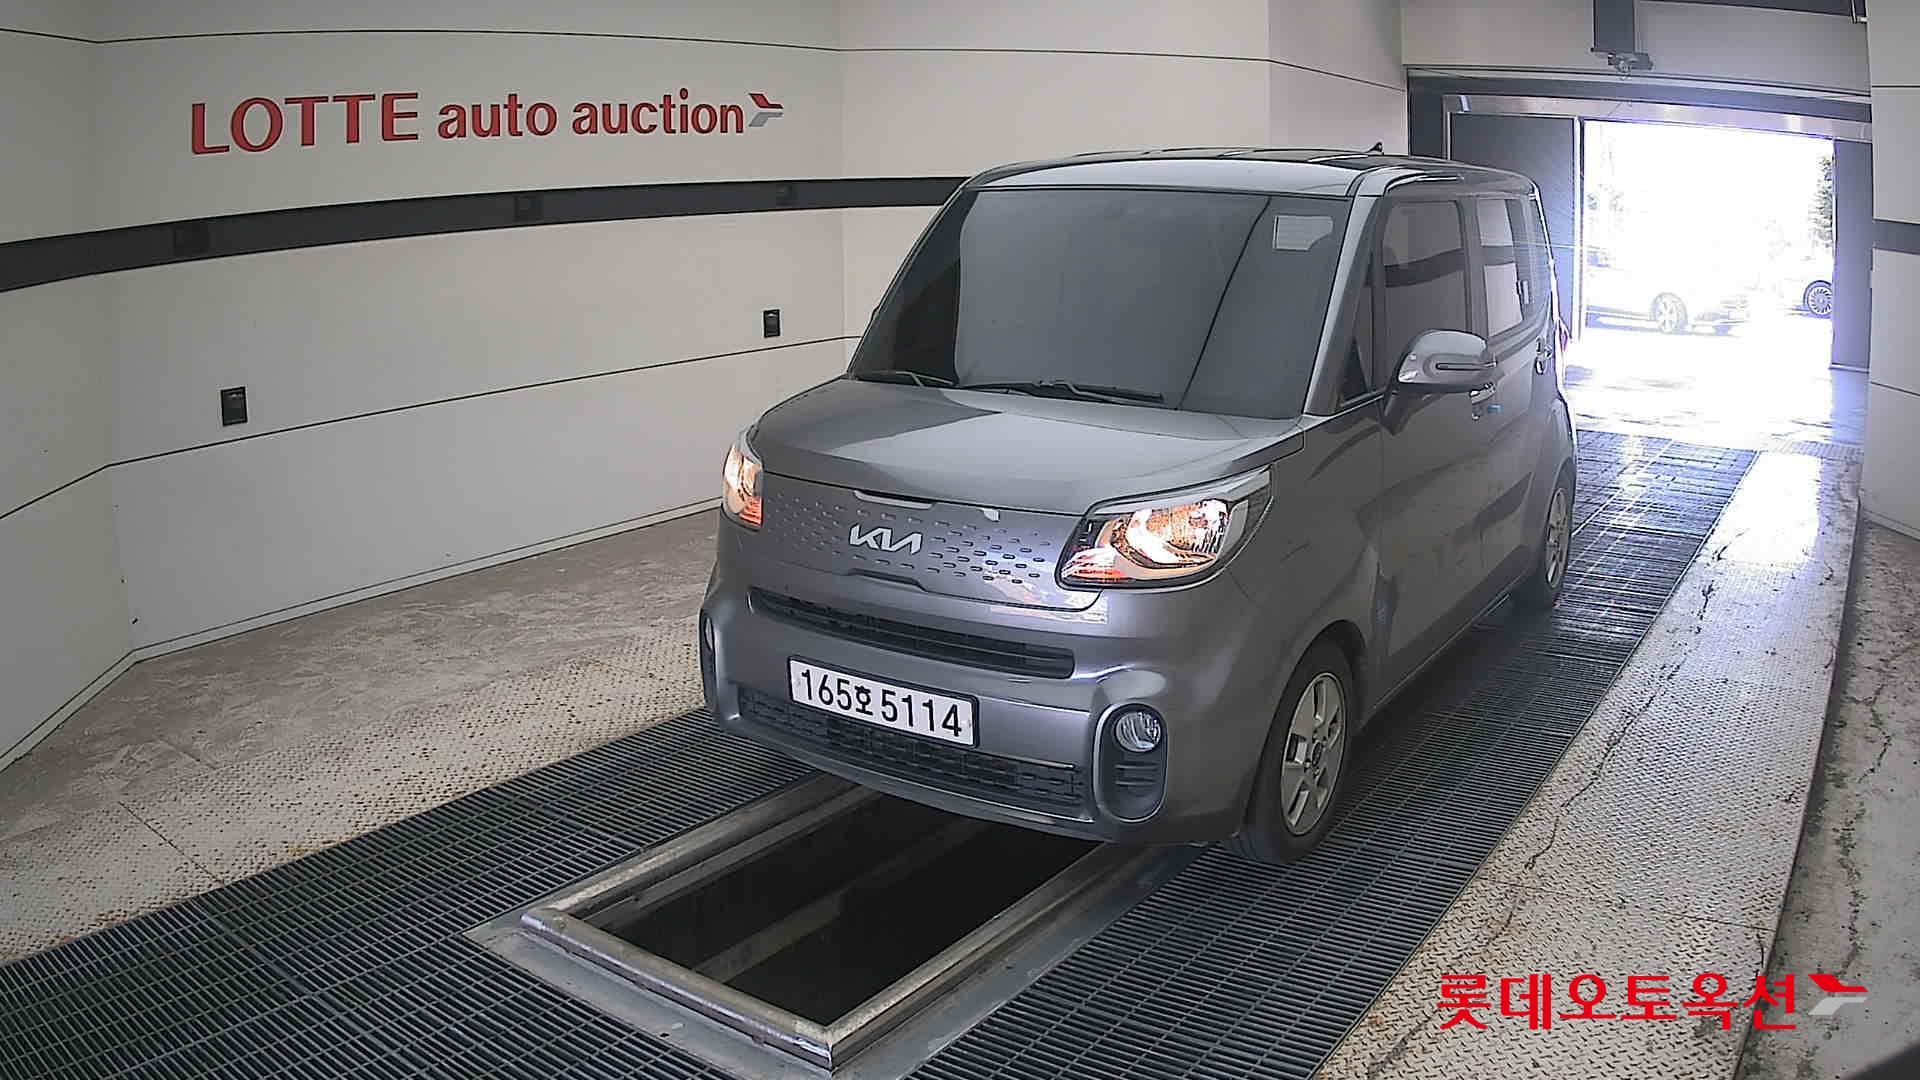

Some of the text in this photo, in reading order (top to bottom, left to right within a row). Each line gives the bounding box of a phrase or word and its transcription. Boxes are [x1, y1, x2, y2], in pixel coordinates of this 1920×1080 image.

[191, 87, 744, 155] LOTTE auto auction
[801, 669, 962, 737] 165호 5114
